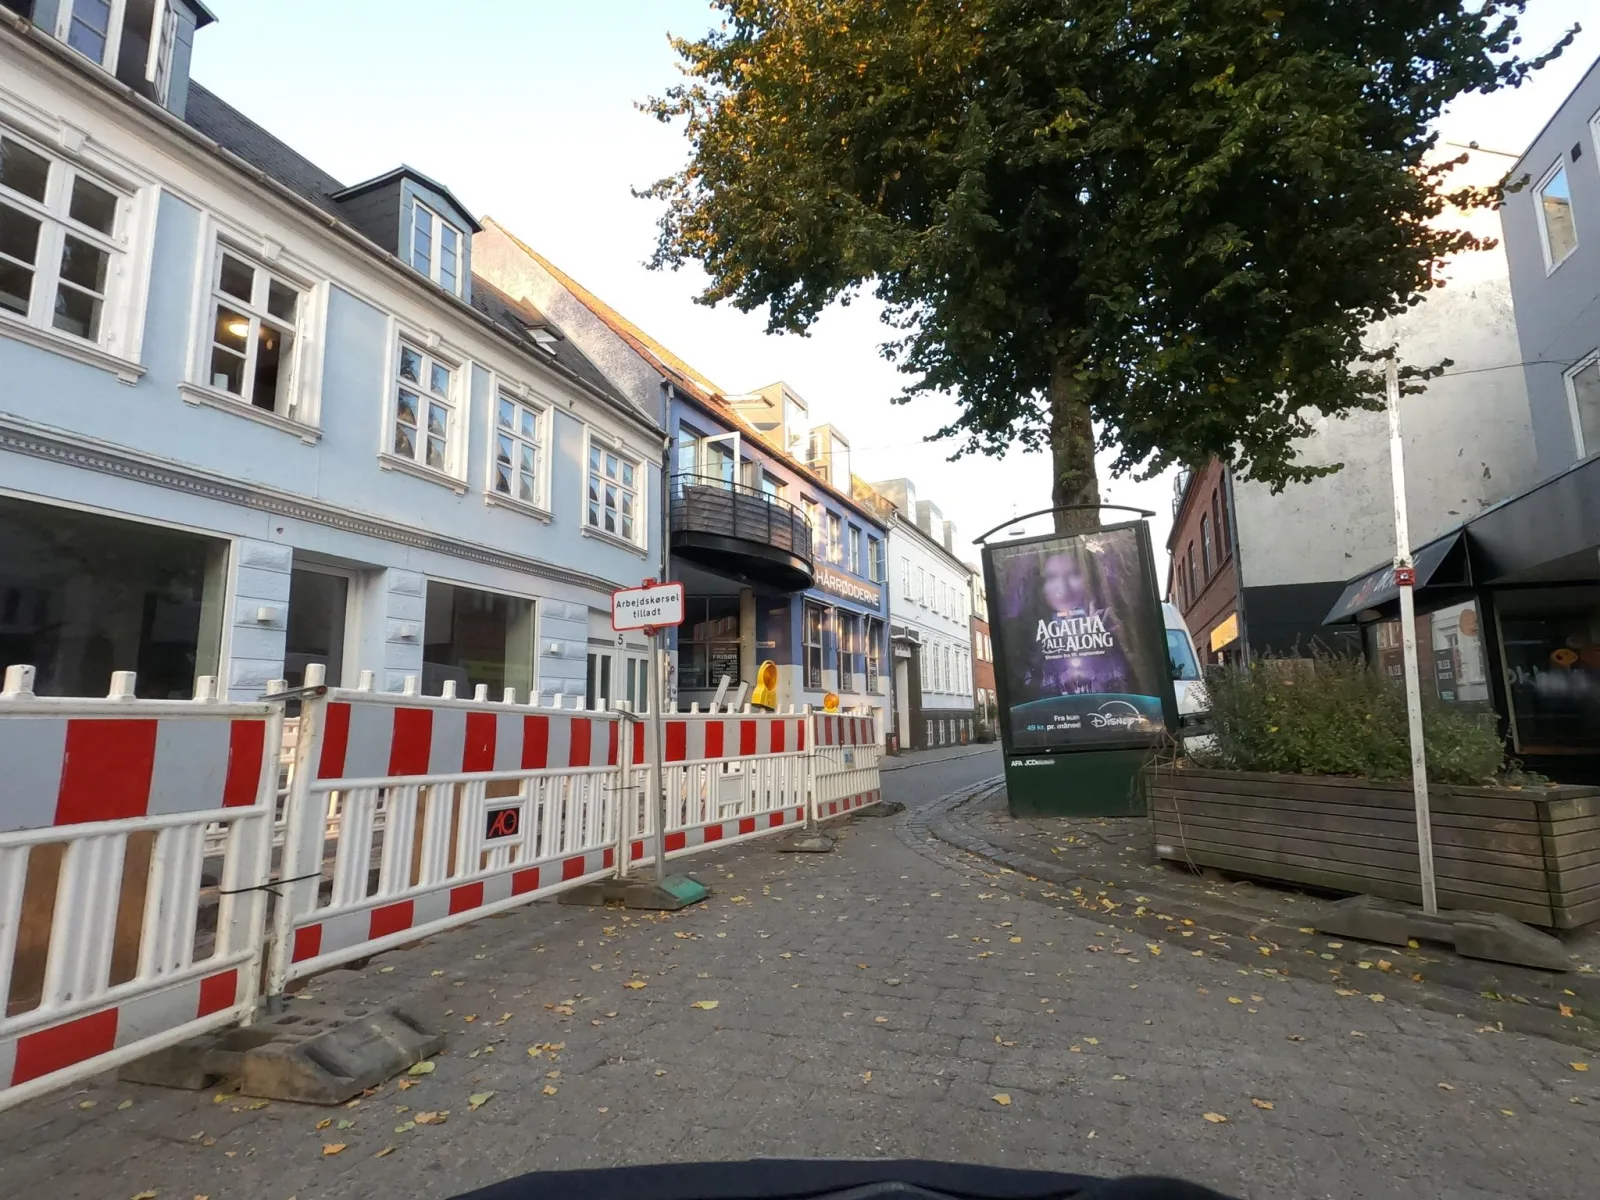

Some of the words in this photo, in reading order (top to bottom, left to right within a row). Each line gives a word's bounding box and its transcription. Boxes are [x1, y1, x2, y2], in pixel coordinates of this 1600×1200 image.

[815, 568, 880, 606] HÅRRØDDERNE
[616, 593, 680, 608] Arbejdskørsel
[633, 608, 662, 618] tilladt
[1036, 615, 1106, 642] AGATHA
[617, 634, 624, 645] 5
[1046, 638, 1065, 649] ALL
[1066, 632, 1114, 651] ALONG
